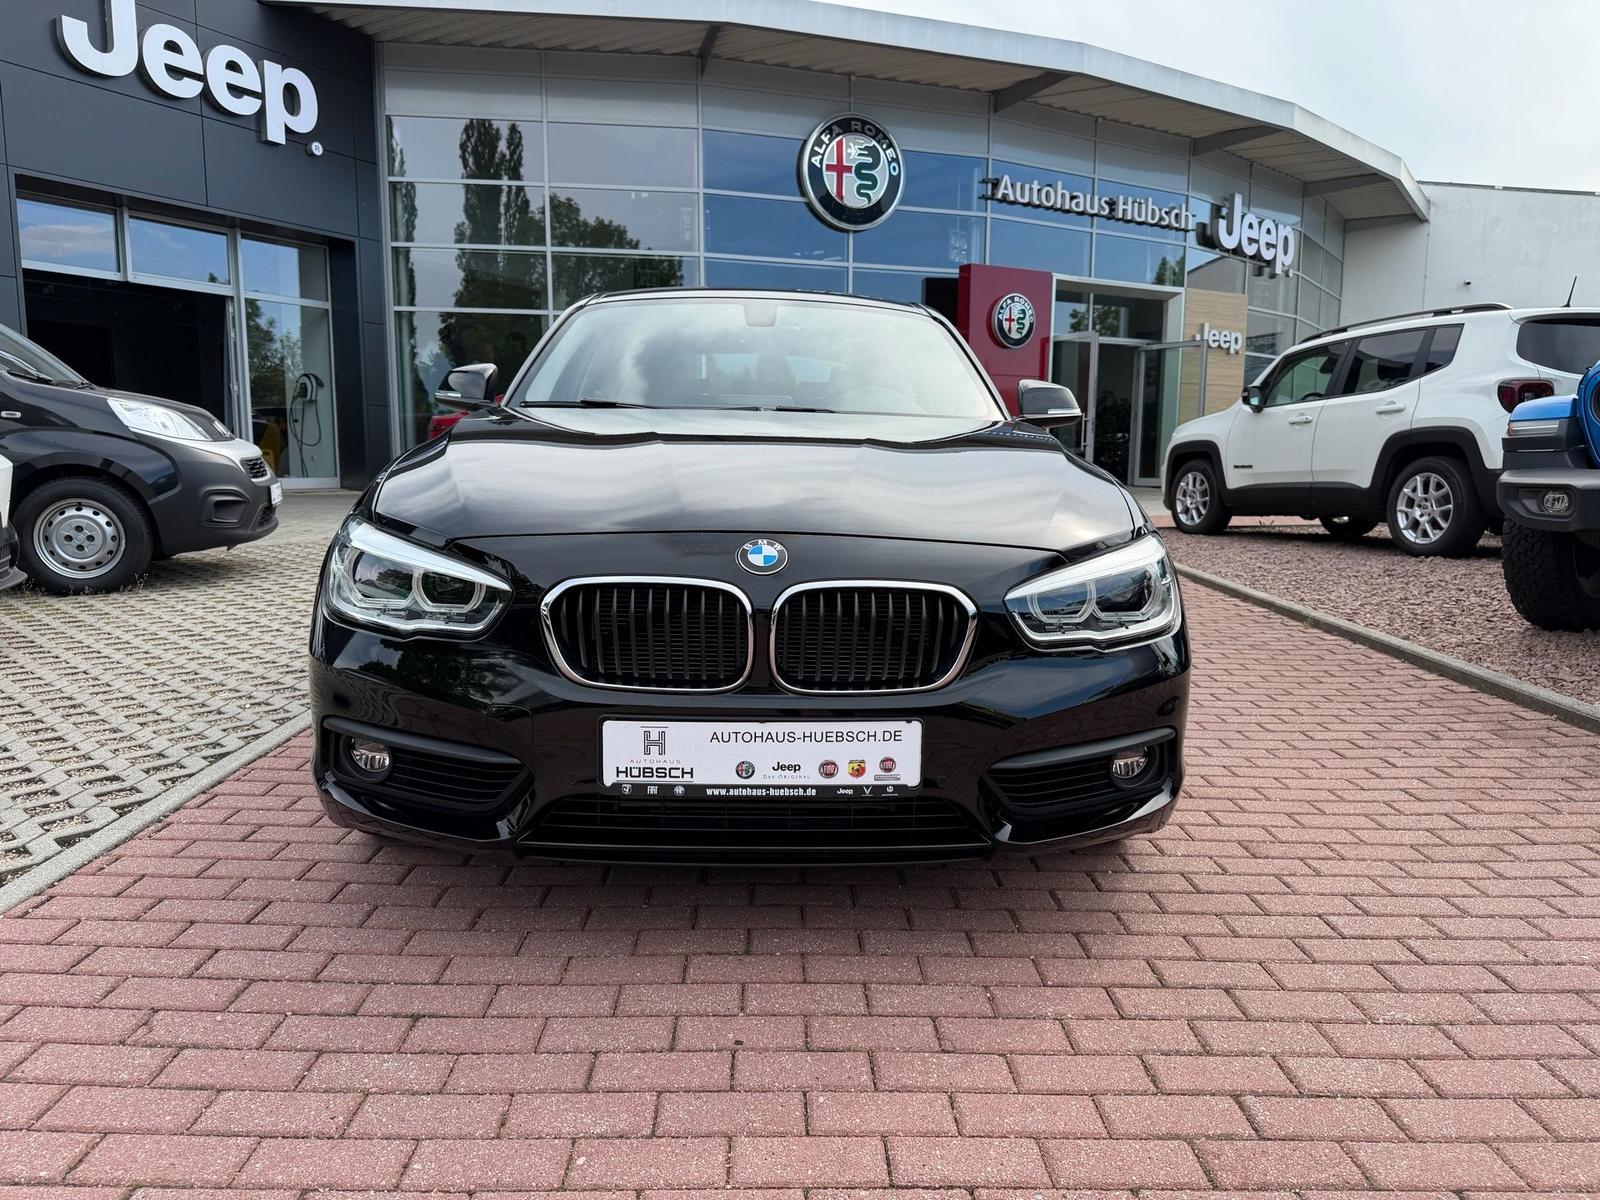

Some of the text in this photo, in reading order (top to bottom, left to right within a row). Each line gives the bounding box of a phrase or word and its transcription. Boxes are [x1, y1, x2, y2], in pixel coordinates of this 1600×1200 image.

[60, 0, 319, 145] Jeep
[811, 120, 899, 176] ALFA ROMEO
[996, 174, 1193, 230] Autohaus Hübsch
[1218, 192, 1295, 275] Jeep
[998, 298, 1012, 320] ALFA
[709, 730, 903, 744] AUTOHAUS-HUEBSCH.DE
[616, 766, 694, 779] HÜBSCH
[772, 761, 801, 773] Jeep
[647, 785, 658, 795] FIAT
[706, 786, 817, 796] www.autohaus-huebsch.de
